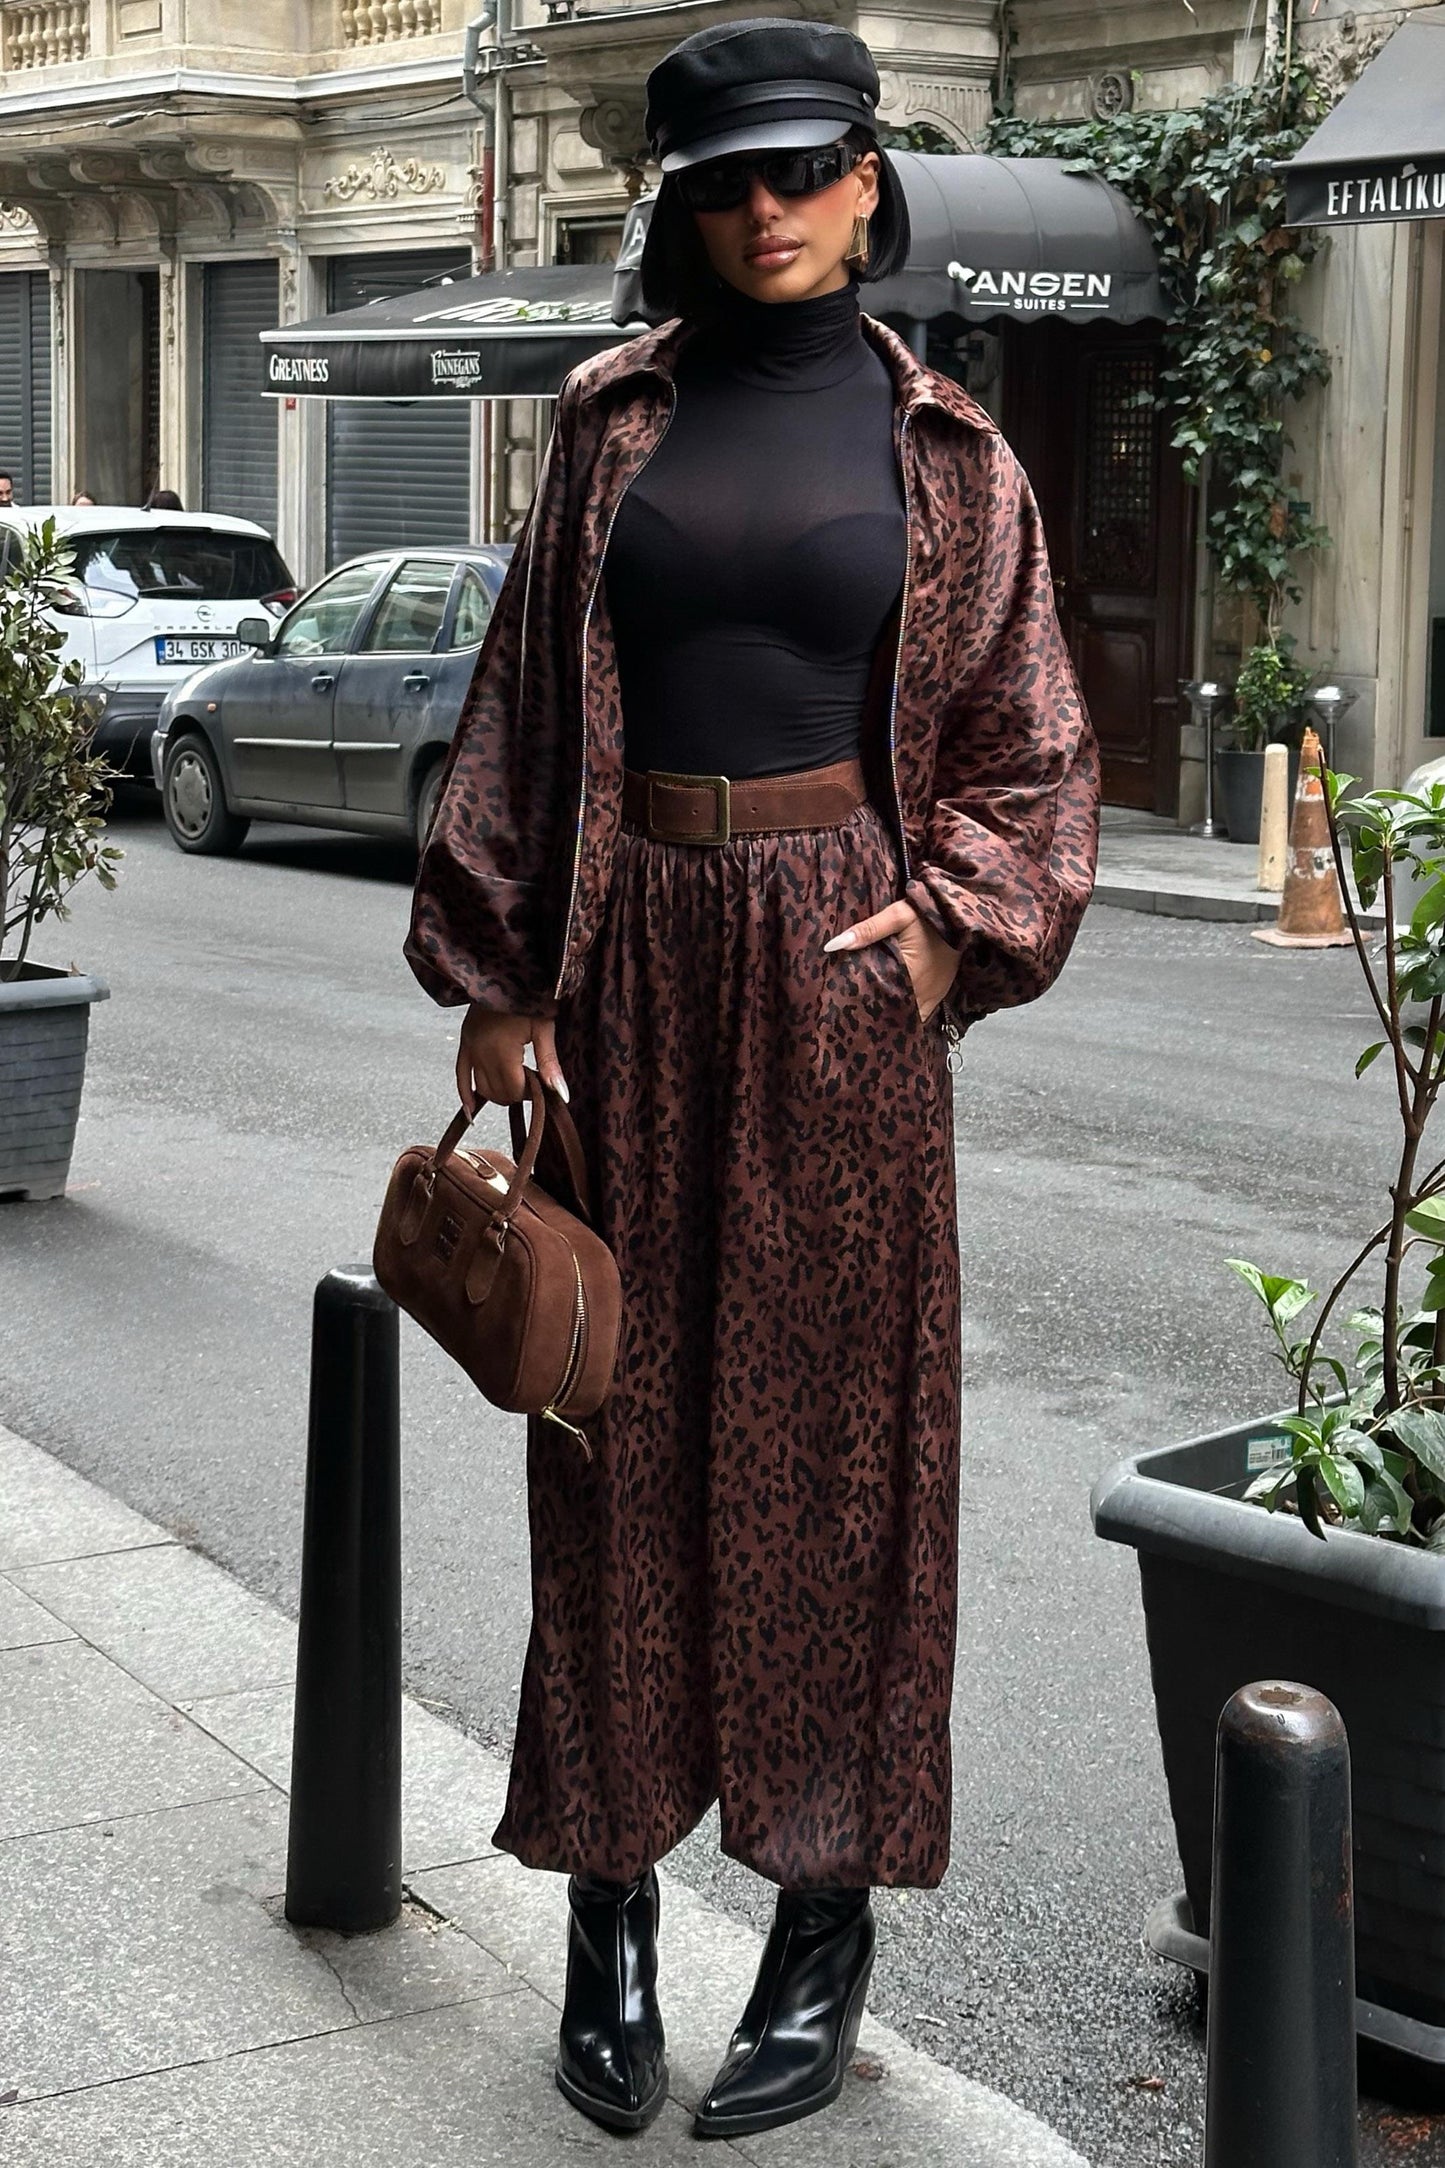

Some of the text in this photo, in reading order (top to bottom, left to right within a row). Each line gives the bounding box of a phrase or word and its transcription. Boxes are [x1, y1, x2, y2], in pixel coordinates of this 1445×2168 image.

[970, 270, 1111, 297] ANSEN
[1013, 299, 1066, 311] SUITES
[269, 354, 329, 382] GREATNESS
[166, 641, 183, 658] 34
[191, 641, 215, 658] GSK
